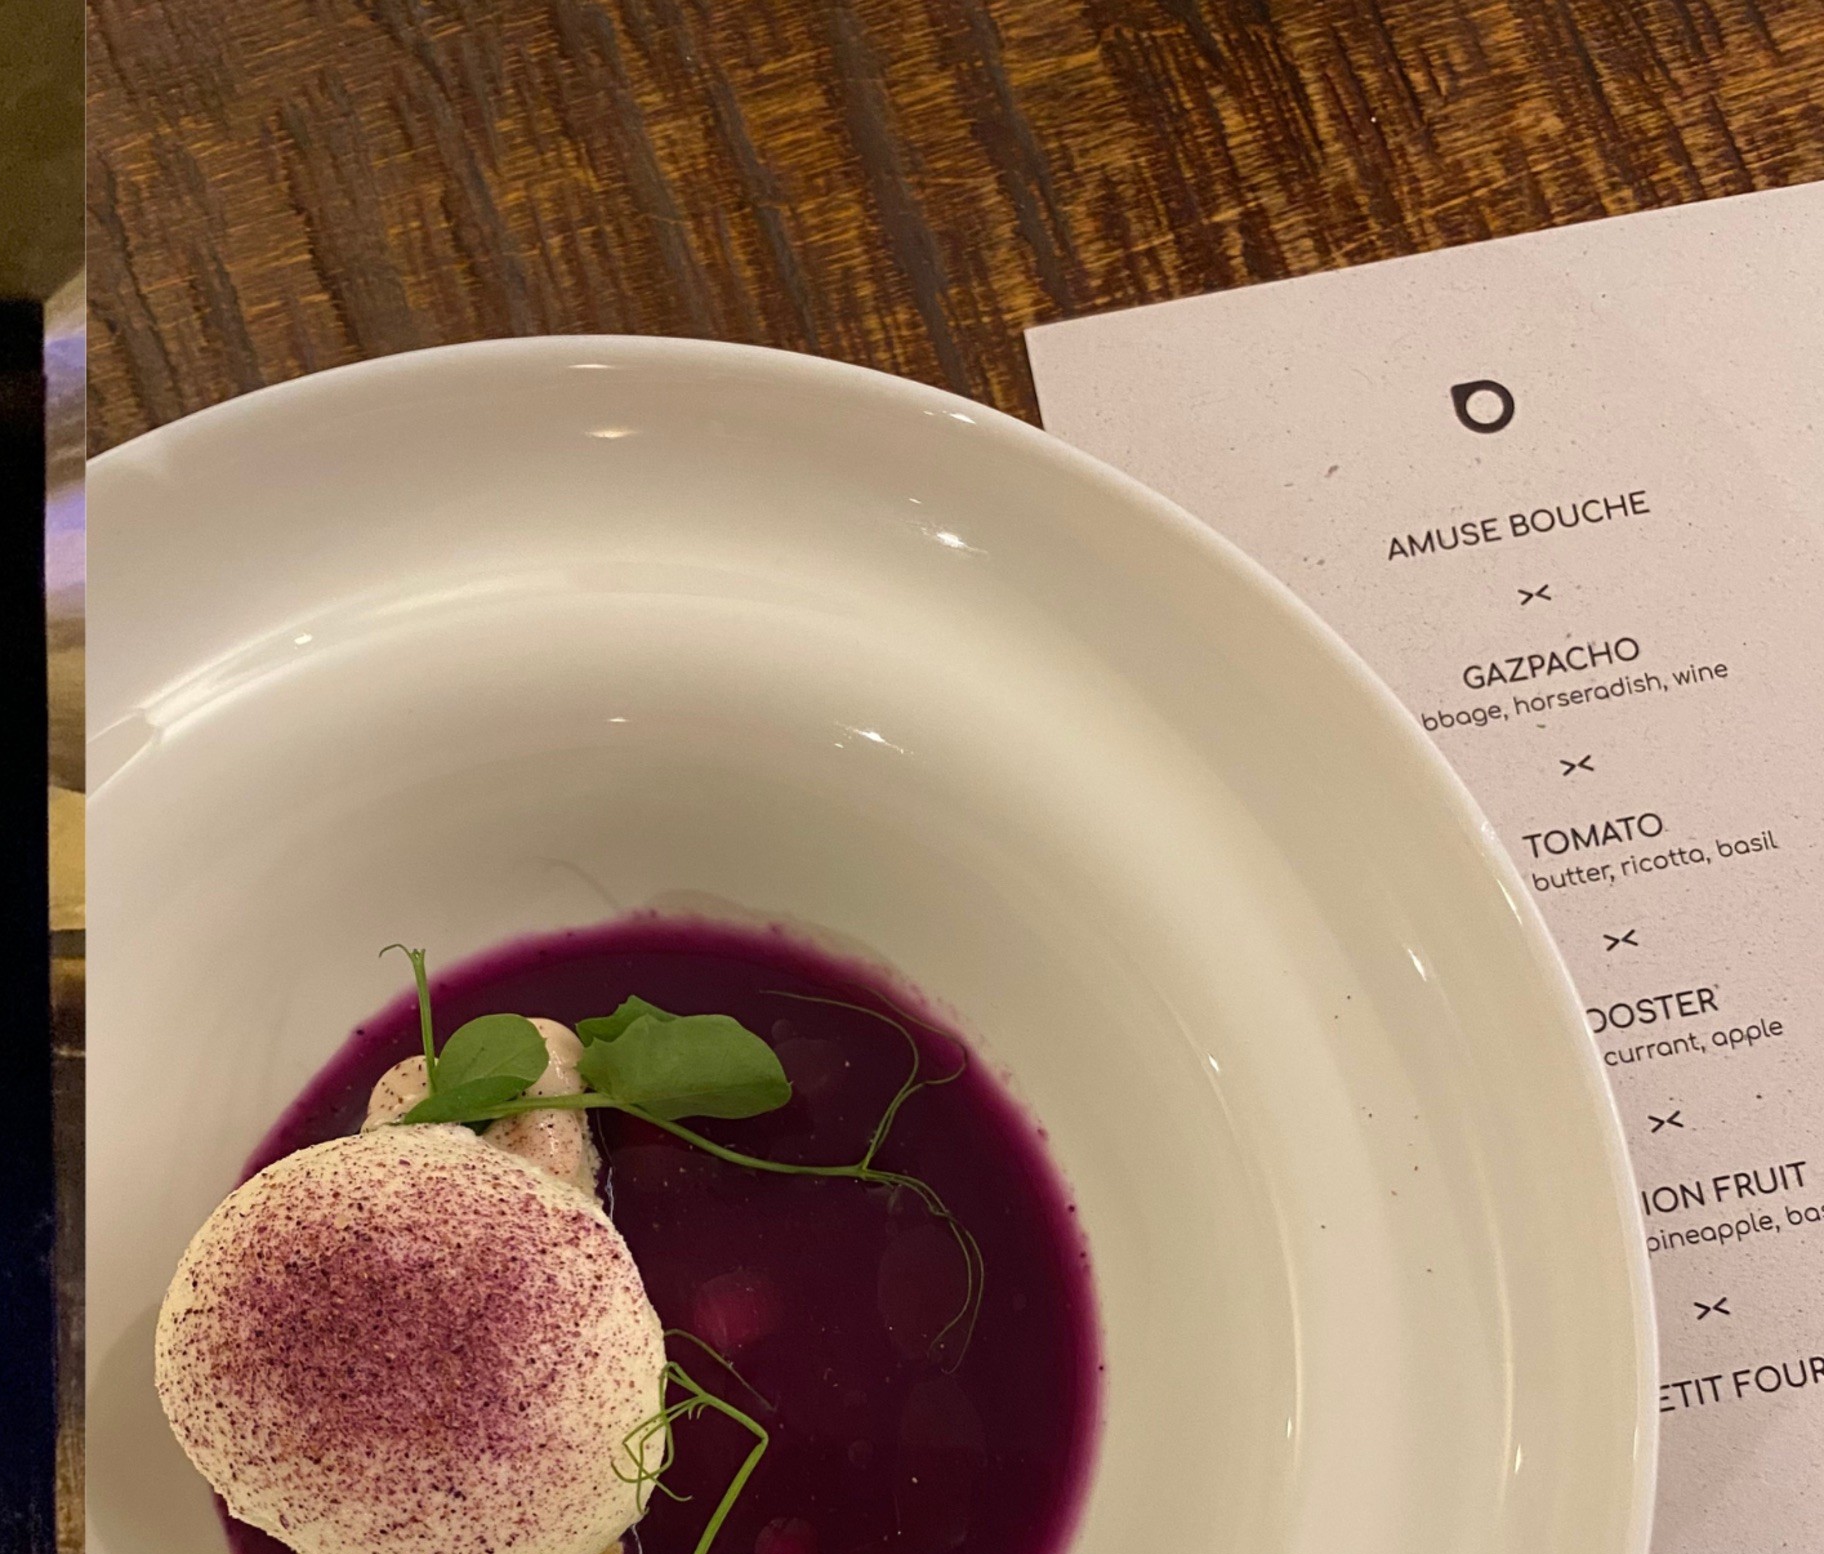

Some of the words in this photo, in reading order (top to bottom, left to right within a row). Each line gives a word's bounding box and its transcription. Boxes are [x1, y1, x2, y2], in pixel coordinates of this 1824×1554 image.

[1387, 517, 1502, 561] AMUSE
[1509, 490, 1650, 537] BOUCHE
[1462, 637, 1640, 689] GAZPACHO
[1421, 703, 1509, 732] bbage,
[1513, 672, 1669, 716] horseradish,
[1673, 661, 1729, 687] wine
[1522, 812, 1664, 858] TOMATO
[1532, 863, 1615, 893] butter,
[1620, 847, 1712, 878] ricotta,
[1715, 829, 1779, 858] basil
[1586, 986, 1719, 1034] OOSTER
[1603, 1032, 1706, 1067] currant,
[1710, 1018, 1784, 1051] apple
[1641, 1180, 1706, 1216] ION
[1711, 1161, 1807, 1203] FRUIT
[1646, 1212, 1781, 1258] pineapple,
[1659, 1374, 1723, 1413] ETIT
